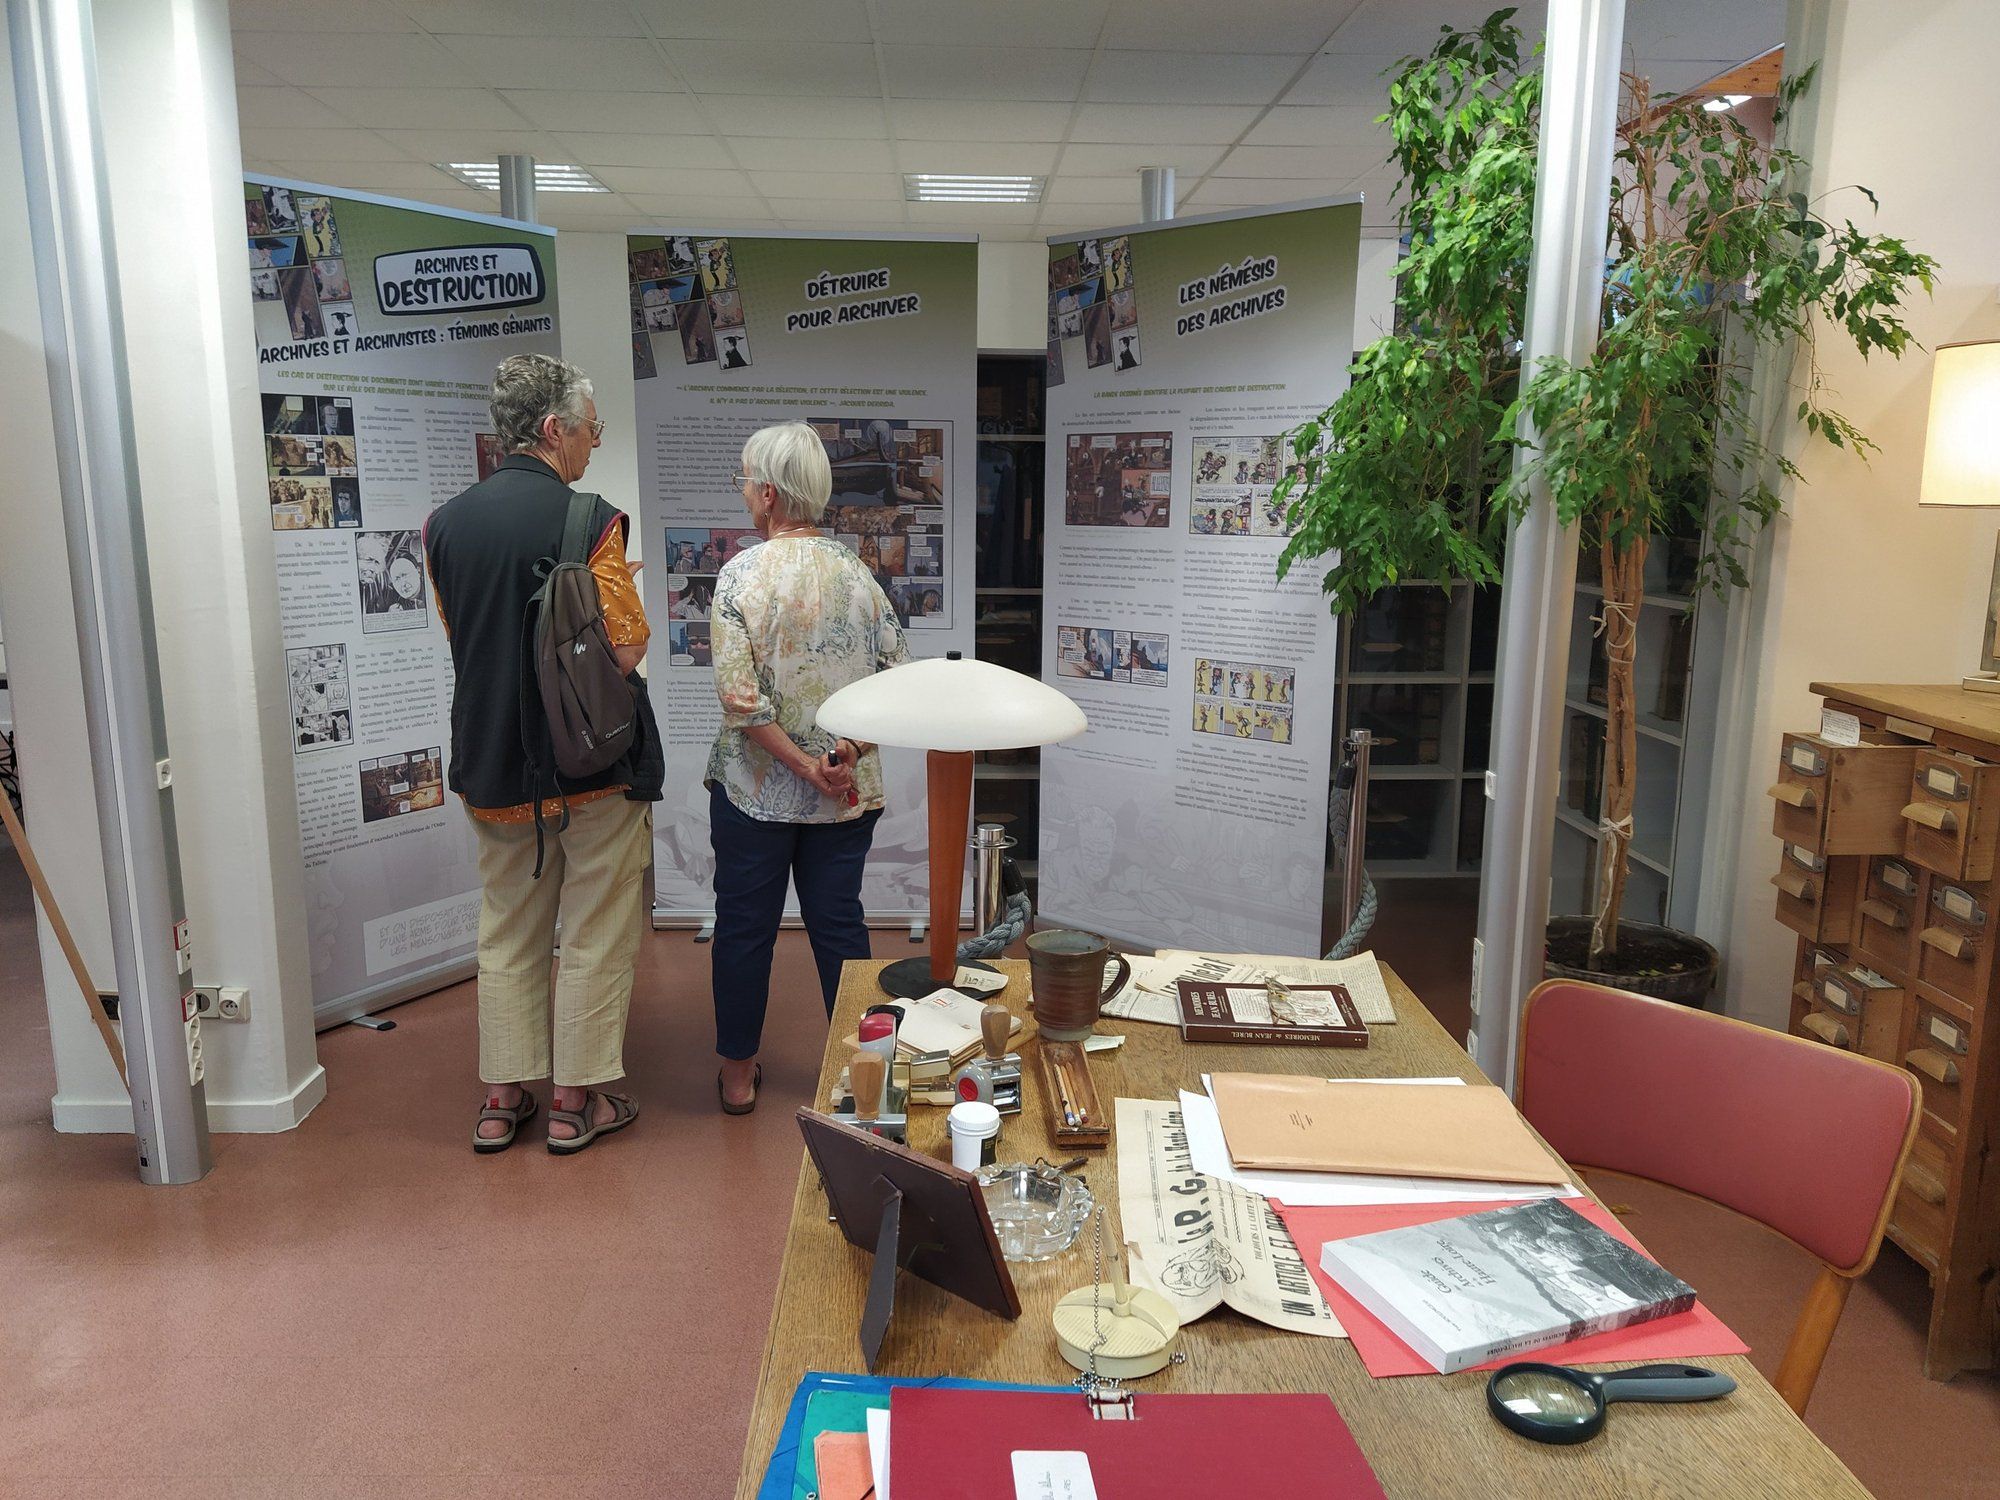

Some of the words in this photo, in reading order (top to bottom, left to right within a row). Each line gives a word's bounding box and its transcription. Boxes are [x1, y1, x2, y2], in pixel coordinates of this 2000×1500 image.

[414, 256, 478, 275] ARCHIVES
[482, 254, 498, 270] ET
[384, 270, 532, 309] DESTRUCTION
[808, 270, 888, 298] DÉTRUIRE
[1180, 280, 1206, 305] LES
[1210, 258, 1276, 294] NÉMÉSIS
[786, 309, 832, 331] POUR
[838, 296, 919, 323] ARCHIVER
[1176, 312, 1206, 336] DES
[1208, 288, 1286, 327] ARCHIVES
[260, 342, 330, 364] ARCHIVES
[334, 338, 350, 354] ET
[354, 329, 436, 352] ARCHIVISTES
[448, 320, 500, 341] TÉMOINS
[503, 314, 551, 336] GÊNANTS
[278, 370, 290, 378] LES
[316, 372, 360, 382] DESTRUCTION
[361, 375, 369, 383] DE
[337, 384, 345, 392] LE
[1268, 1236, 1298, 1250] ET
[1272, 1254, 1312, 1296] ARTICLE
[1436, 1240, 1496, 1284] Haute-Loire
[1420, 1270, 1452, 1294] Guide
[1280, 1298, 1316, 1316] UN
